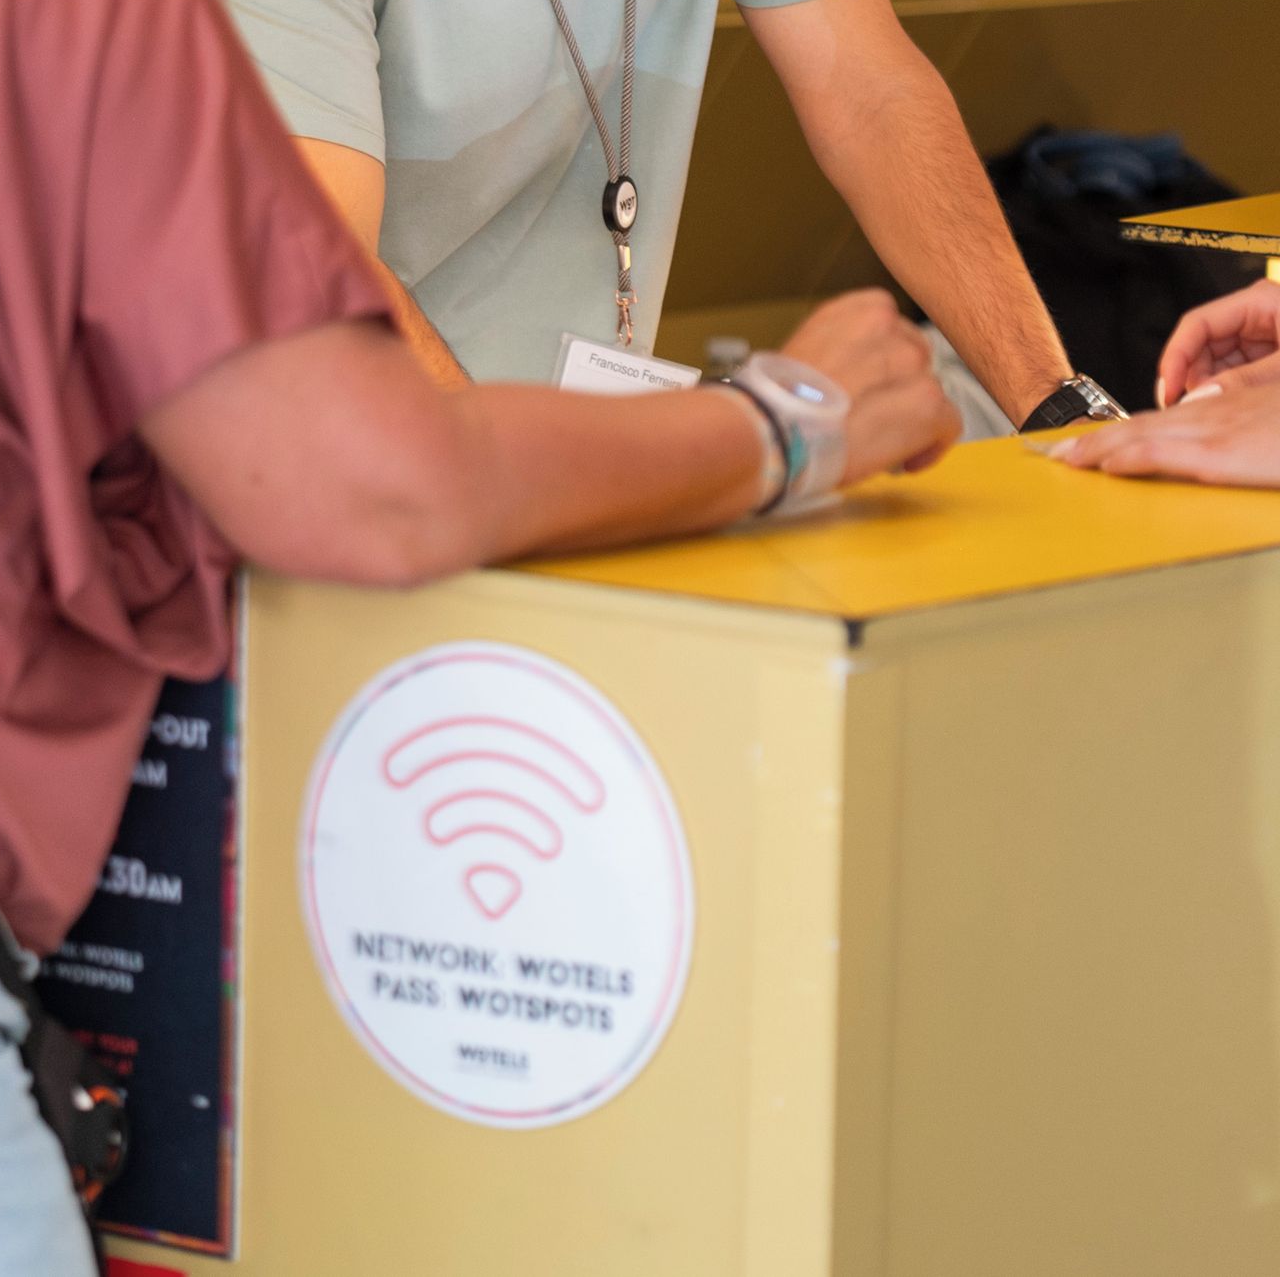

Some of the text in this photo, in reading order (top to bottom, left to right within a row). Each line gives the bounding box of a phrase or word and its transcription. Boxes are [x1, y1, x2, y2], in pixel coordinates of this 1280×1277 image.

[589, 353, 640, 379] Francisco
[517, 956, 634, 997] WOTELS
[458, 986, 615, 1034] WOTSPOTS
